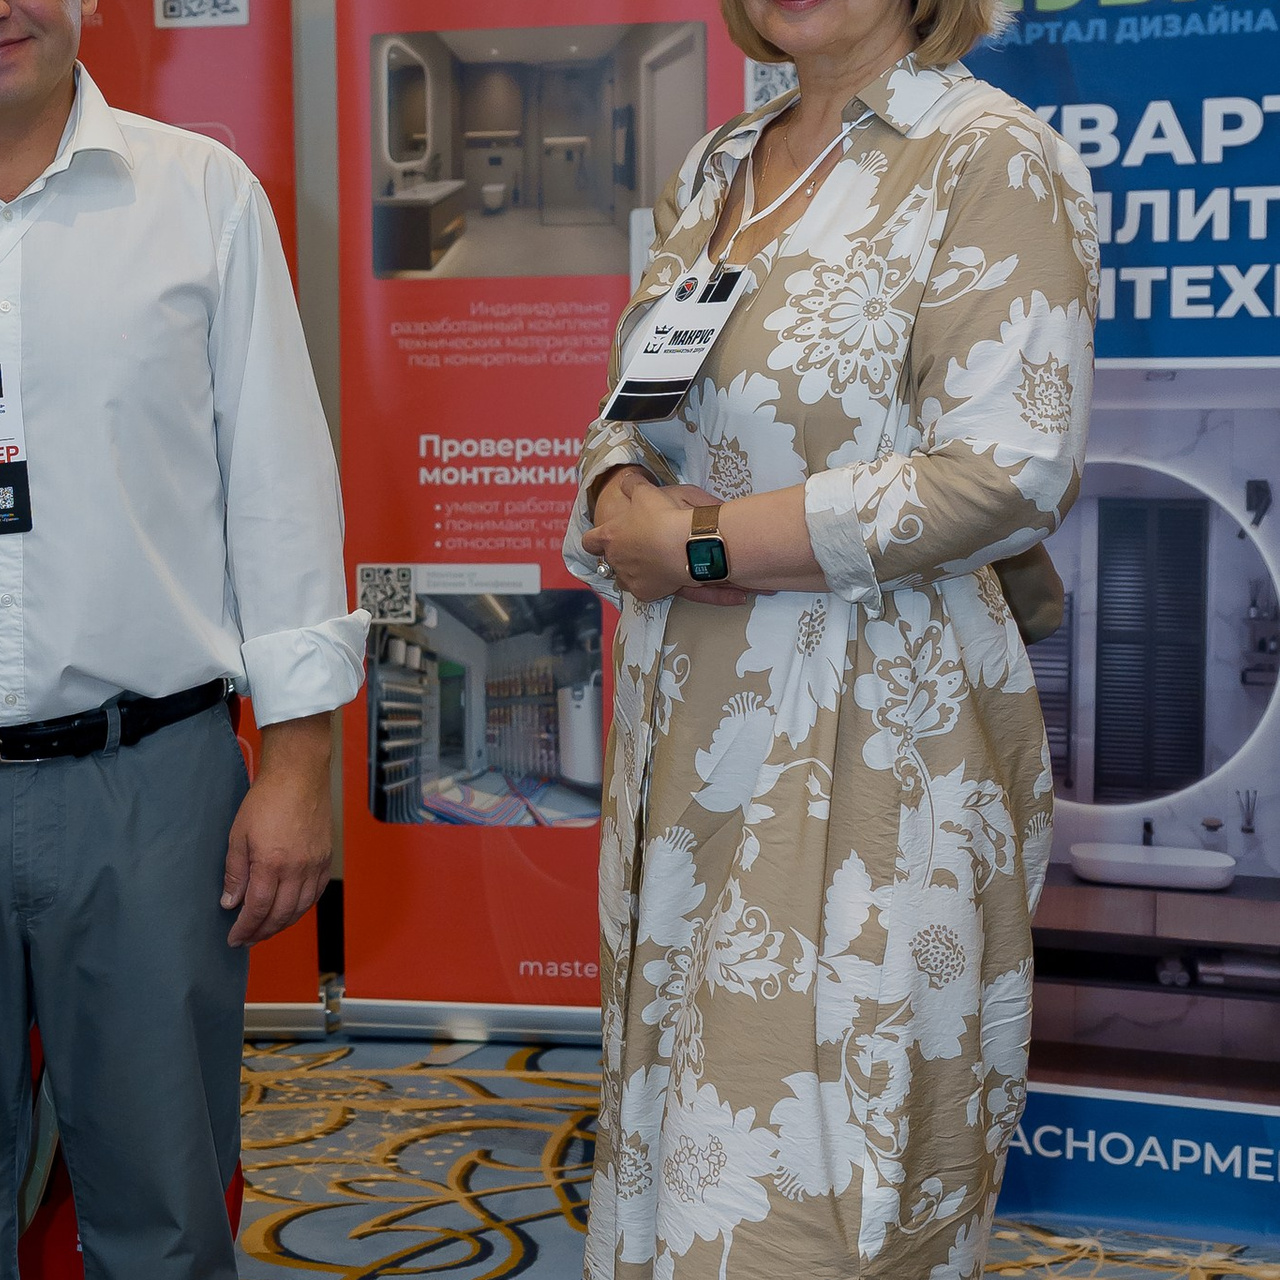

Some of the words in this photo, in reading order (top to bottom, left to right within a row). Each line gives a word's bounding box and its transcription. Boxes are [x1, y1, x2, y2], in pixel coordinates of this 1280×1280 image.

[1115, 5, 1278, 45] ДИЗАЙНА
[1036, 95, 1280, 168] ВАР
[1099, 264, 1280, 320] ТЕХ
[668, 329, 715, 345] МАКРУС
[419, 466, 577, 485] монтажни
[519, 960, 599, 978] maste
[1005, 1123, 1280, 1182] АСНОАРМЕ
